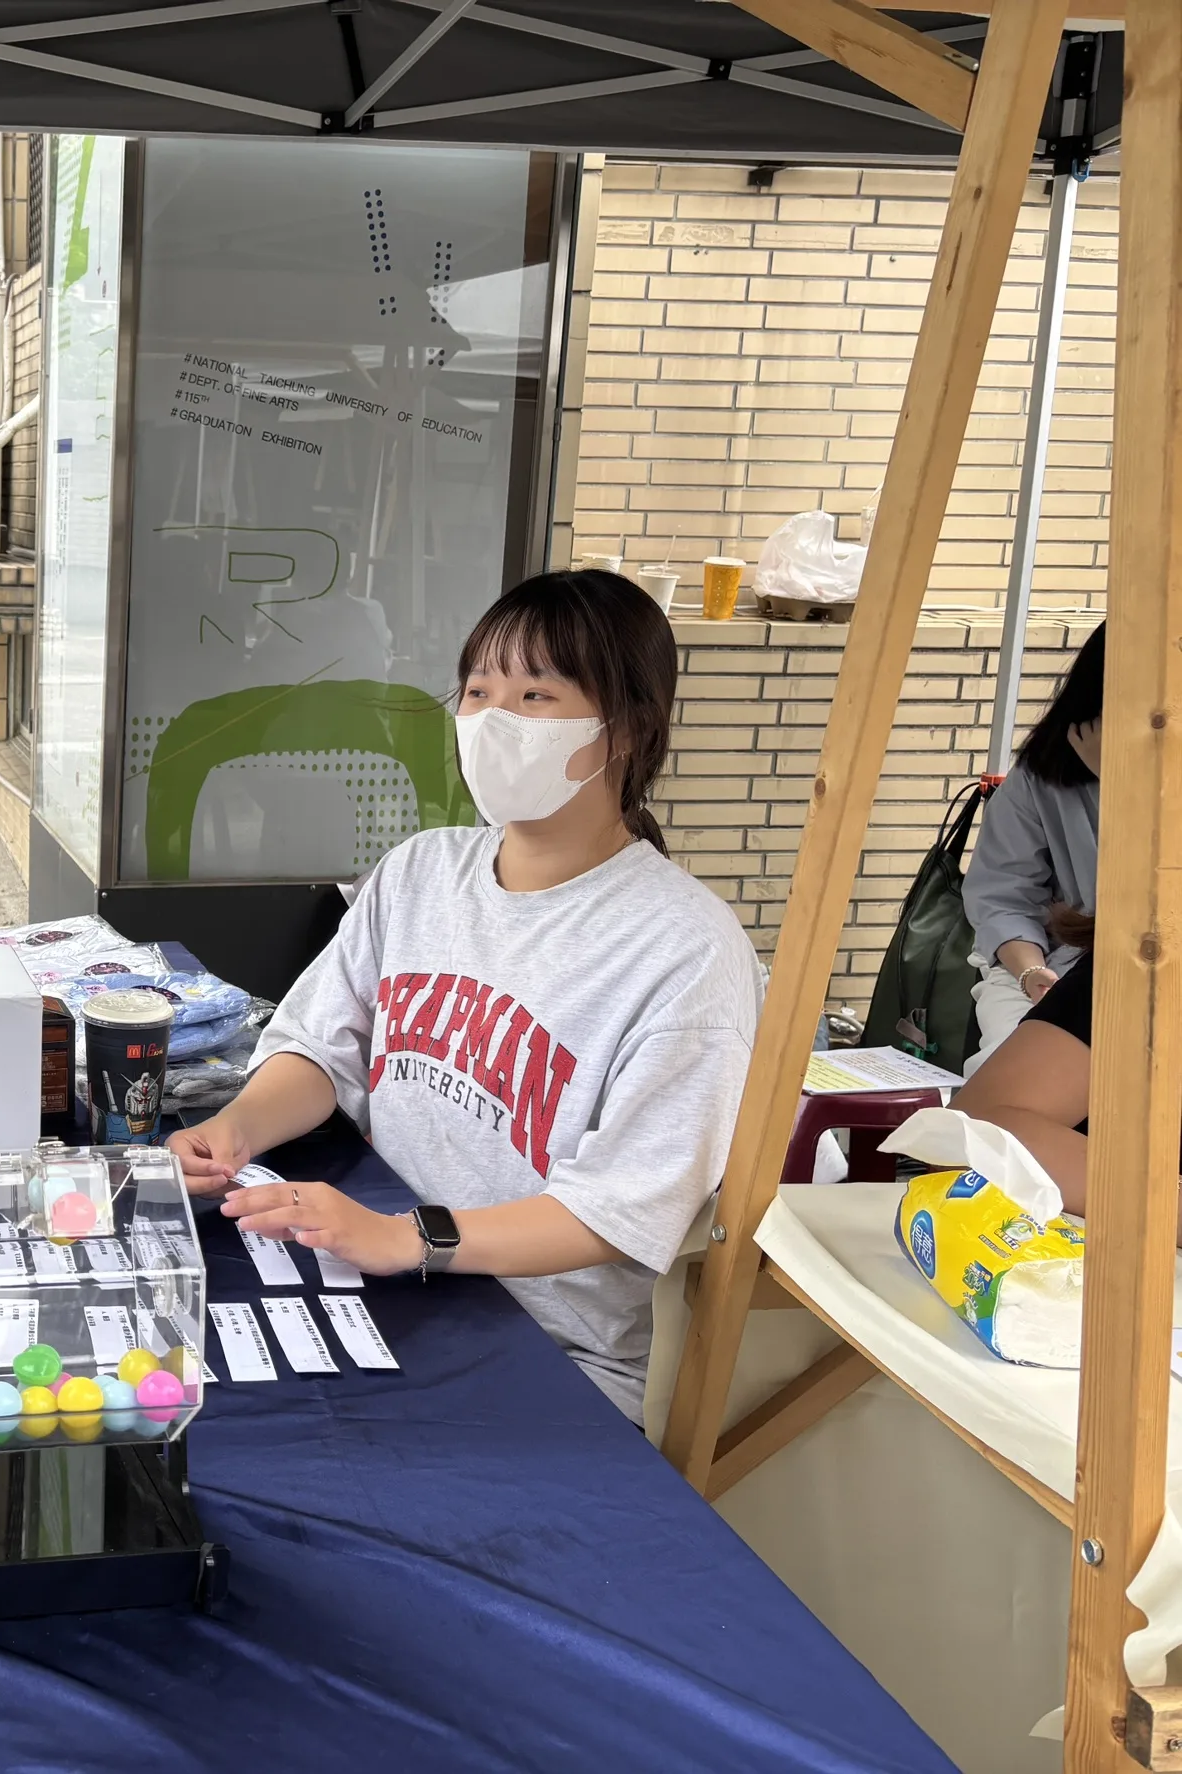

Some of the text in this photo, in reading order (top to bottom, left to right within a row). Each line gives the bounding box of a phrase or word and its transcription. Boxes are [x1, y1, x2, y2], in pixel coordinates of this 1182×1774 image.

[224, 383, 241, 395] OF
[242, 388, 269, 403] FINE
[269, 396, 299, 411] ARTS
[260, 373, 316, 397] TAICHUNG
[326, 391, 388, 416] UNIVERSITY
[398, 411, 413, 423] OF
[422, 418, 483, 443] EDUCATION
[262, 431, 322, 455] EXHIBITION
